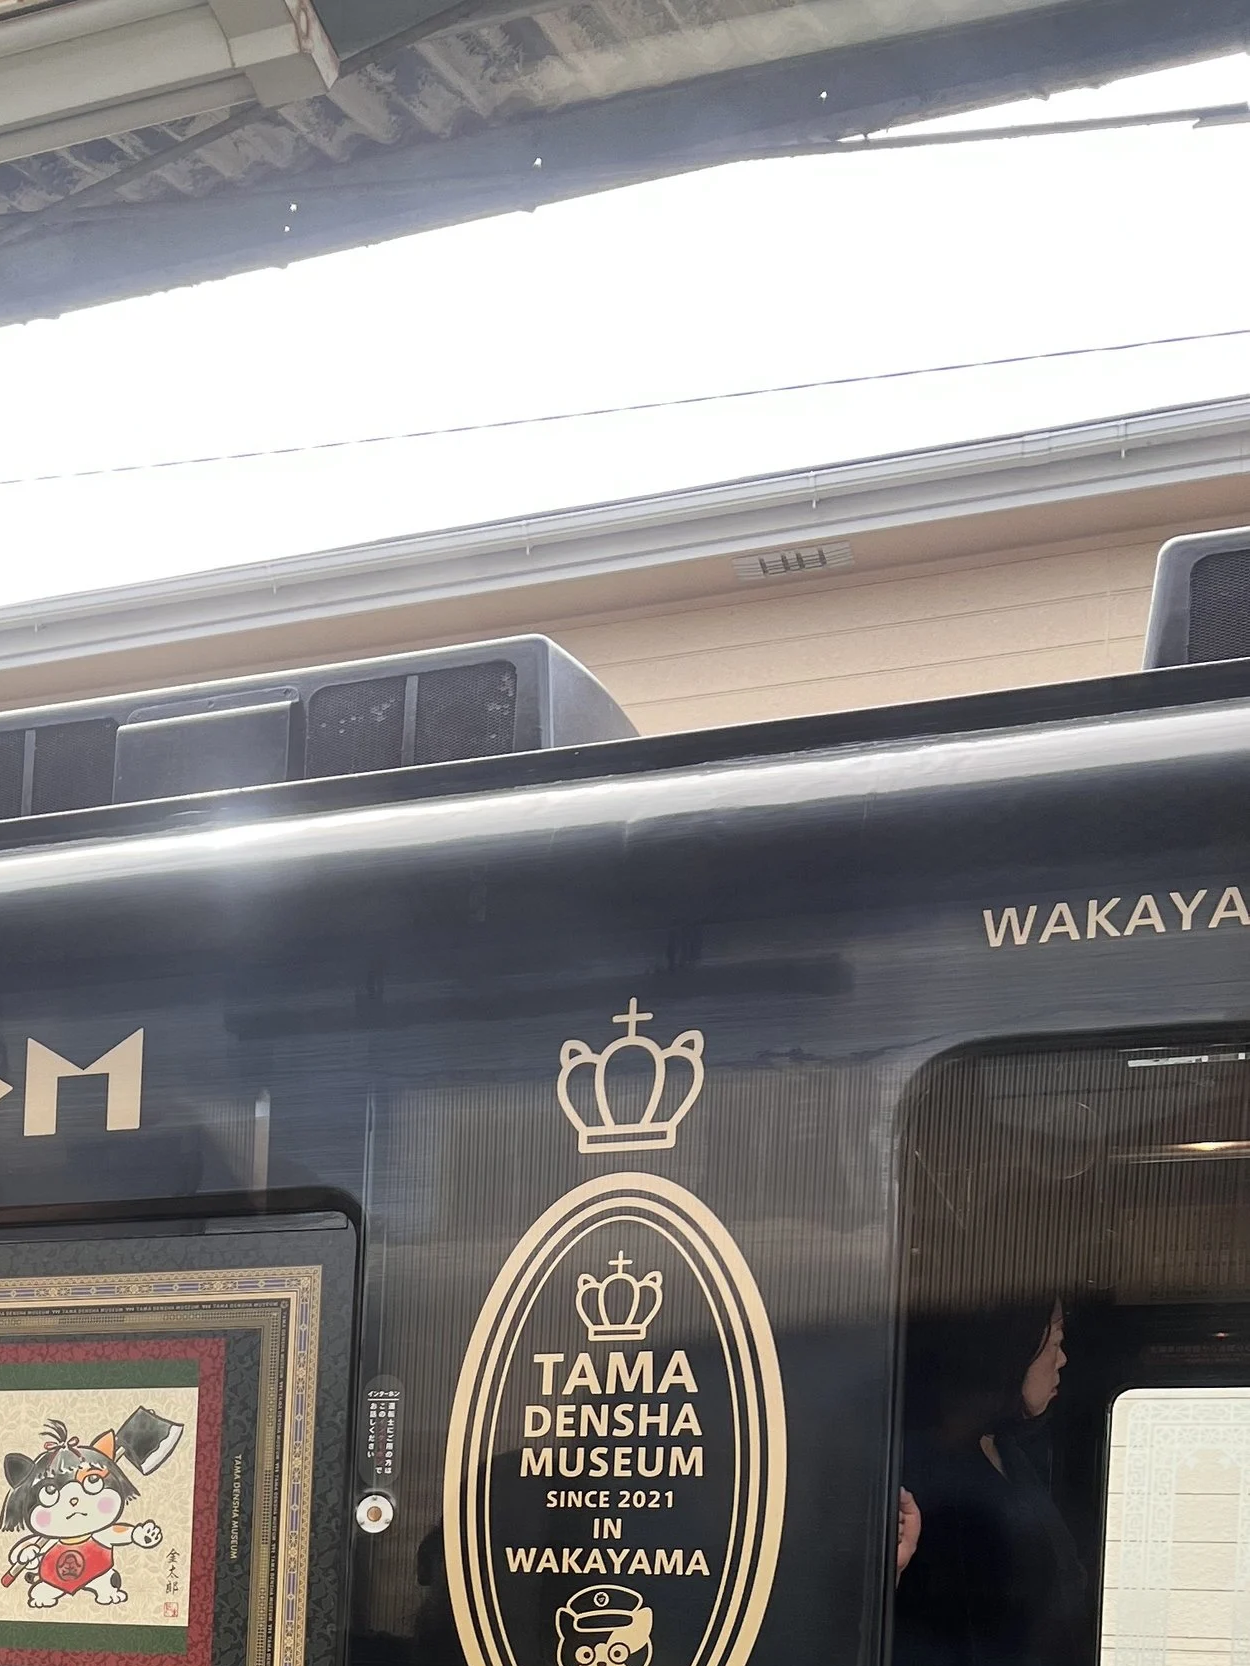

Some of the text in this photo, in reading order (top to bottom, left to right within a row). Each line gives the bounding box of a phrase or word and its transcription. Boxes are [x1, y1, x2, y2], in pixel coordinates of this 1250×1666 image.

[982, 886, 1250, 948] WAKAYA
[533, 1350, 699, 1396] TAMA
[367, 1390, 401, 1398] インターホン
[523, 1402, 703, 1438] DENSHA
[519, 1446, 704, 1478] MUSEUM
[230, 1454, 241, 1560] TAMA DENSHA MUSEUM
[546, 1490, 675, 1508] SINCE 2021
[592, 1518, 623, 1540] IN
[165, 1548, 181, 1594] 金太郎
[505, 1547, 711, 1577] WAKAYAMA
